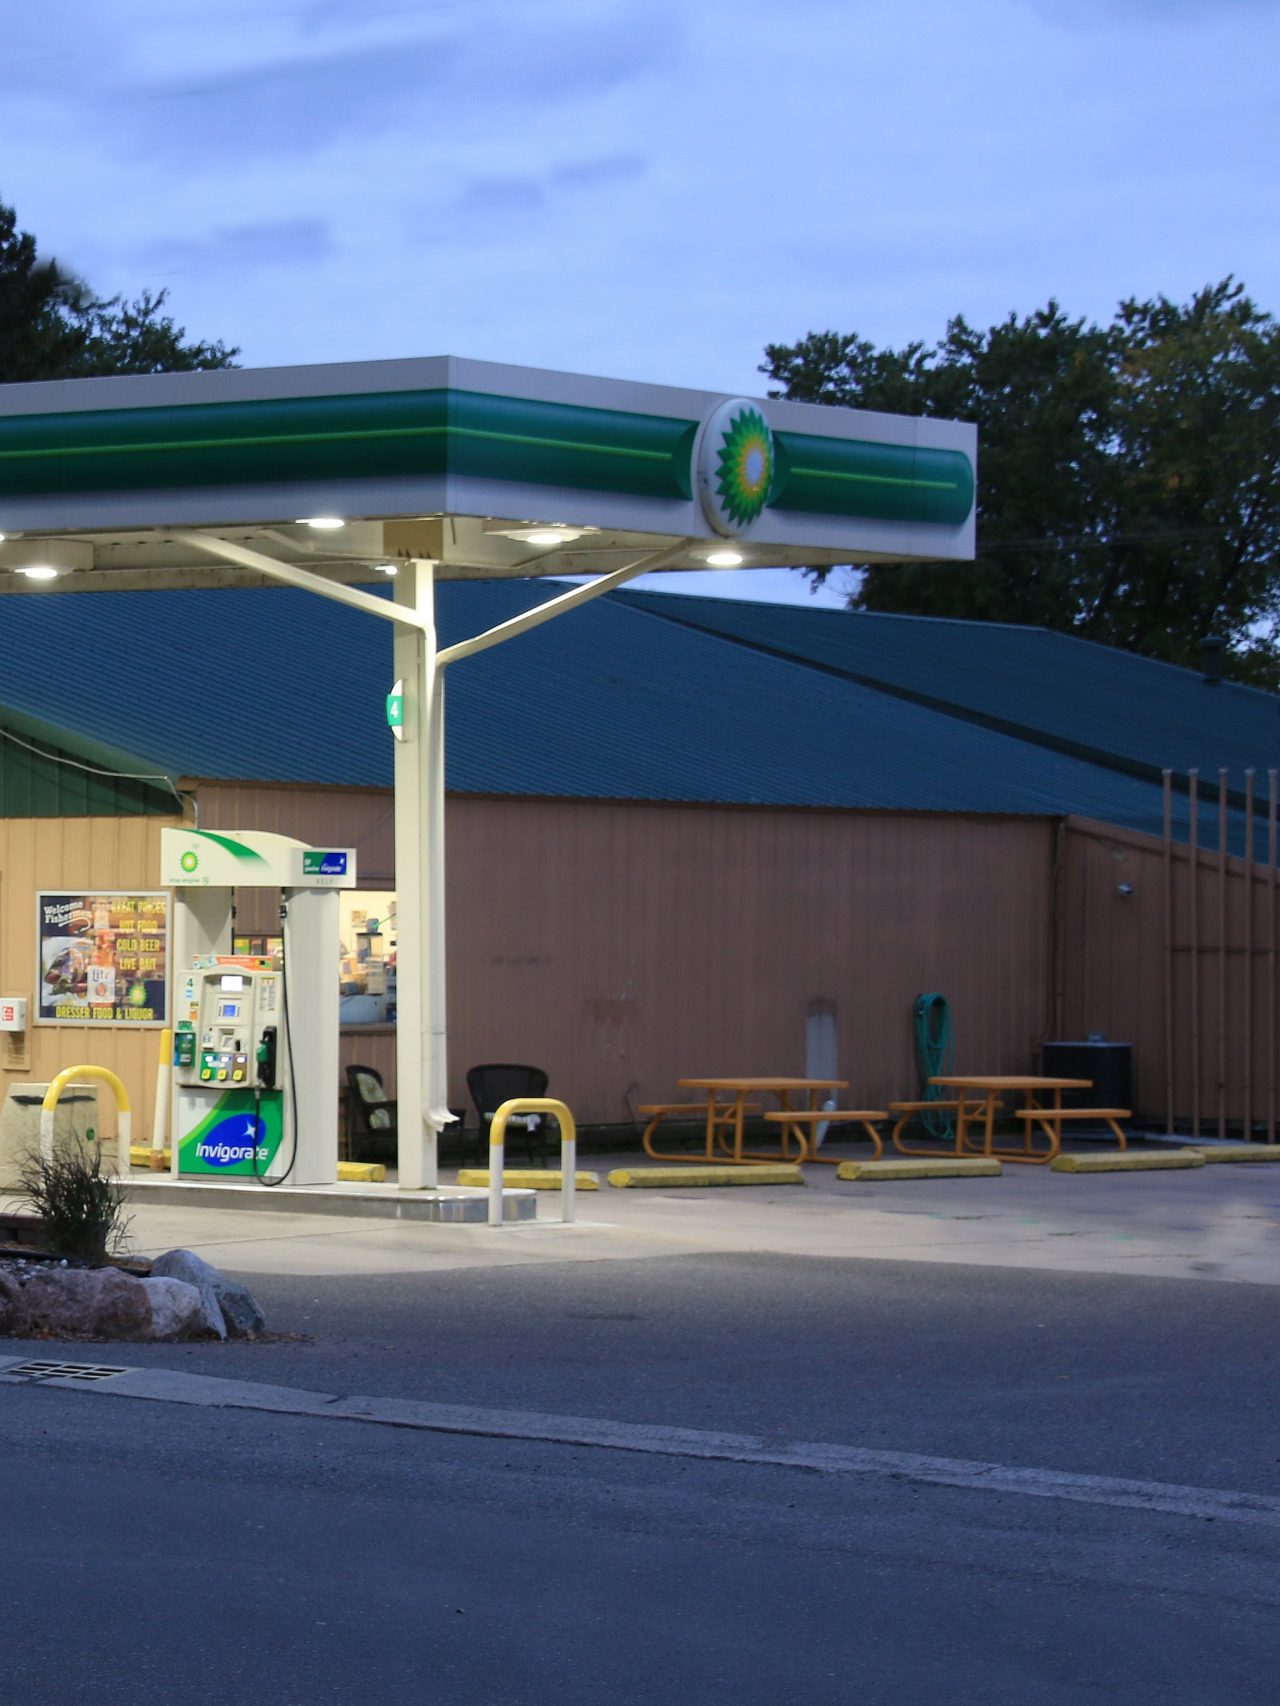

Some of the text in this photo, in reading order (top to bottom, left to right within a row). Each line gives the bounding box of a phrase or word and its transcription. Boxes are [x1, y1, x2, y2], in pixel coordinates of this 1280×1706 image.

[390, 701, 399, 718] 4
[44, 901, 84, 915] Welcome
[137, 920, 158, 932] FOOD
[116, 939, 160, 952] COLD BEER
[119, 958, 158, 970] LIVE BAIT
[56, 1006, 90, 1018] DRESSER
[93, 1008, 114, 1019] FOOD
[124, 1008, 154, 1020] LIQUOR
